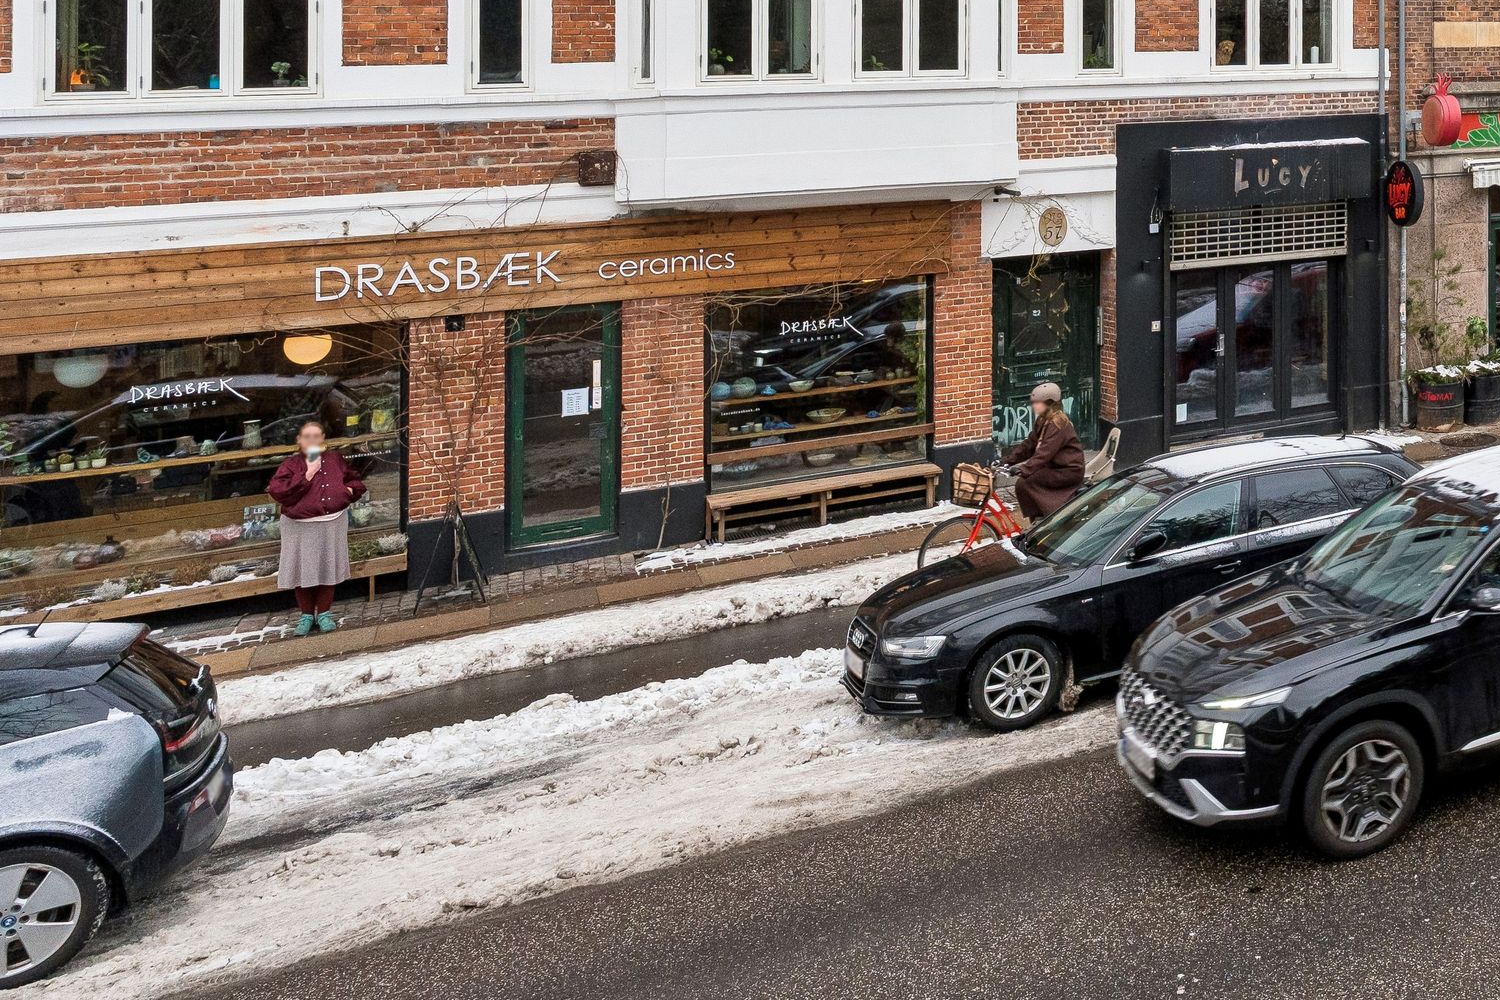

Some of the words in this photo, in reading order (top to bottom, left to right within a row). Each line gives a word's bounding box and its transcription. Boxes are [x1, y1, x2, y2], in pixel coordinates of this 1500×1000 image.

[1234, 158, 1313, 197] LUCY
[315, 250, 561, 302] DRASBÆK
[599, 249, 735, 279] ceramics
[779, 315, 864, 337] DRASBÆK
[790, 334, 841, 344] CERAMICS
[127, 377, 250, 403] DRASBÆK
[143, 400, 217, 413] CERAMICS
